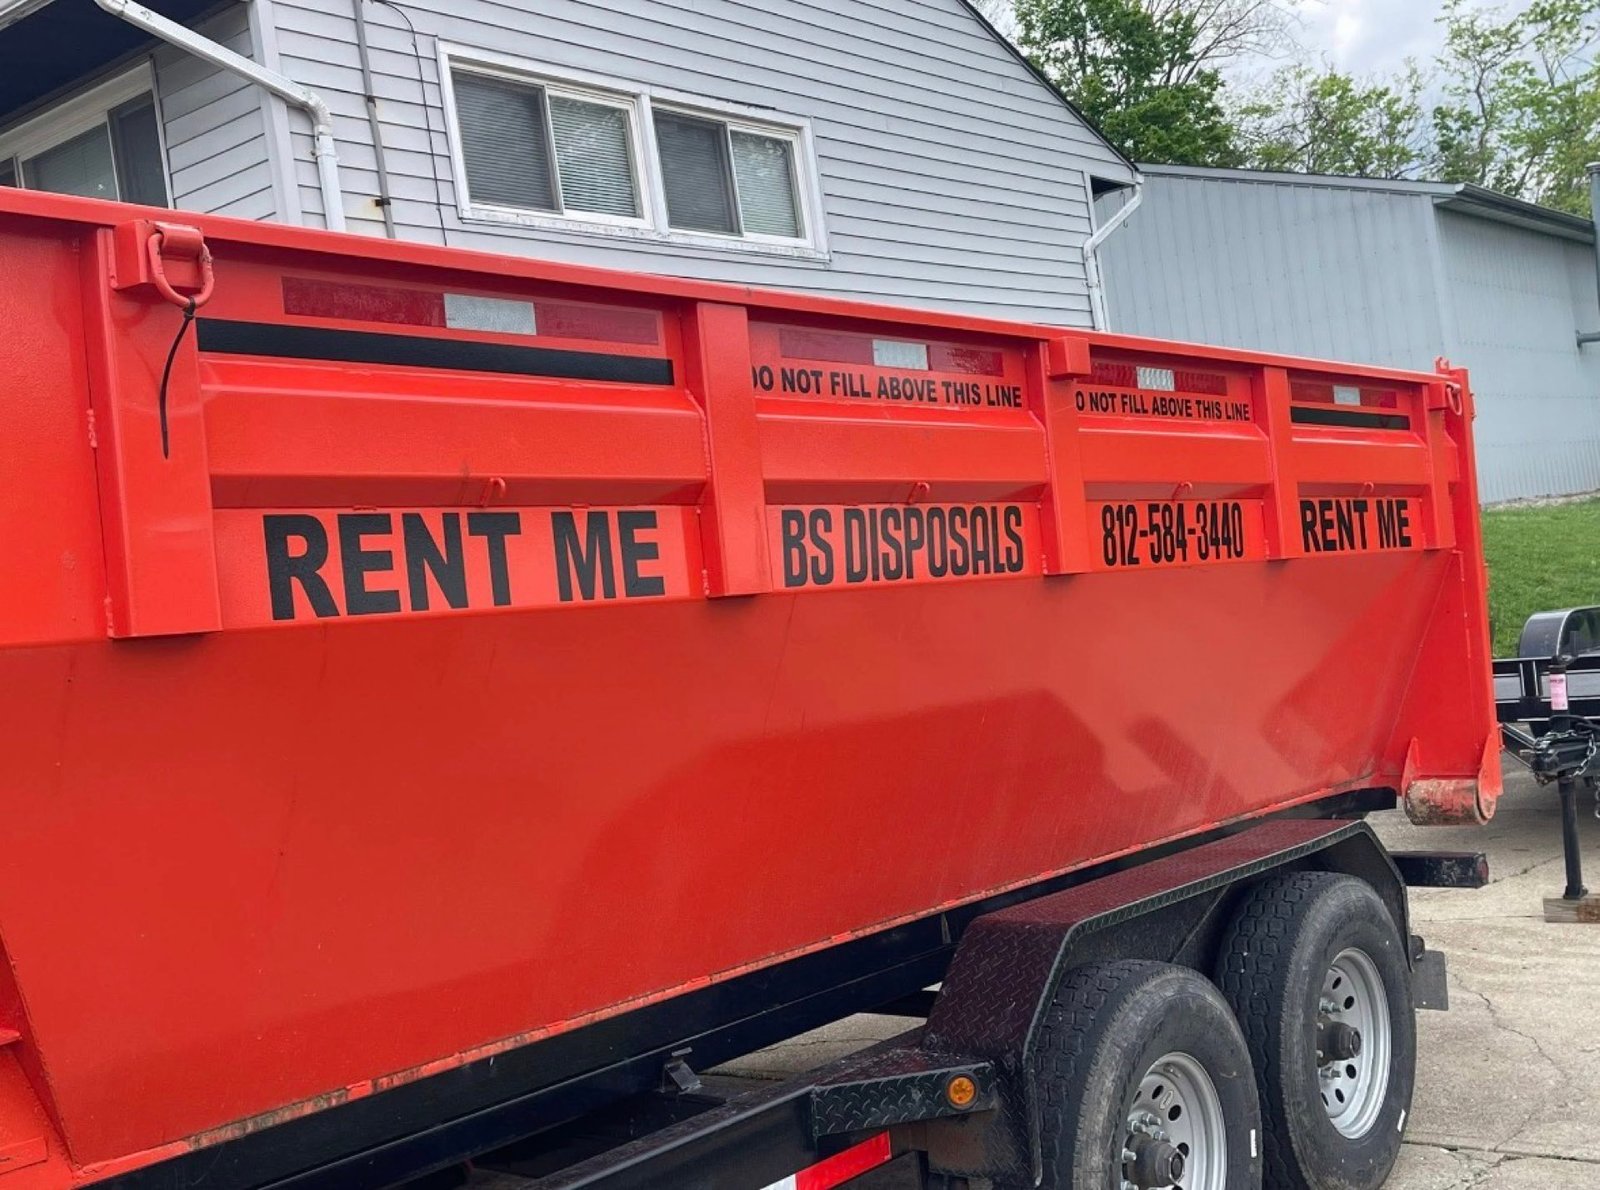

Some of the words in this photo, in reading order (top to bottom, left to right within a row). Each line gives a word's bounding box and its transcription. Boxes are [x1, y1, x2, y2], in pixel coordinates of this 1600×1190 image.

[752, 365, 774, 391] O
[781, 368, 823, 394] NOT
[831, 373, 872, 398] FILL
[877, 376, 938, 402] ABOVE
[942, 381, 982, 405] THIS
[987, 385, 1023, 408] LINE
[1089, 392, 1117, 413] NOT
[1121, 394, 1149, 414] FILL
[1152, 397, 1193, 417] ABOVE
[1195, 400, 1222, 420] THIS
[1225, 402, 1250, 421] LINE
[781, 508, 834, 588] BS
[843, 505, 1025, 583] DISPOSALS
[1101, 502, 1245, 567] 812-584-3440
[1300, 499, 1369, 553] RENT
[1376, 499, 1413, 549] ME
[263, 511, 522, 621] RENT
[550, 510, 666, 602] ME
